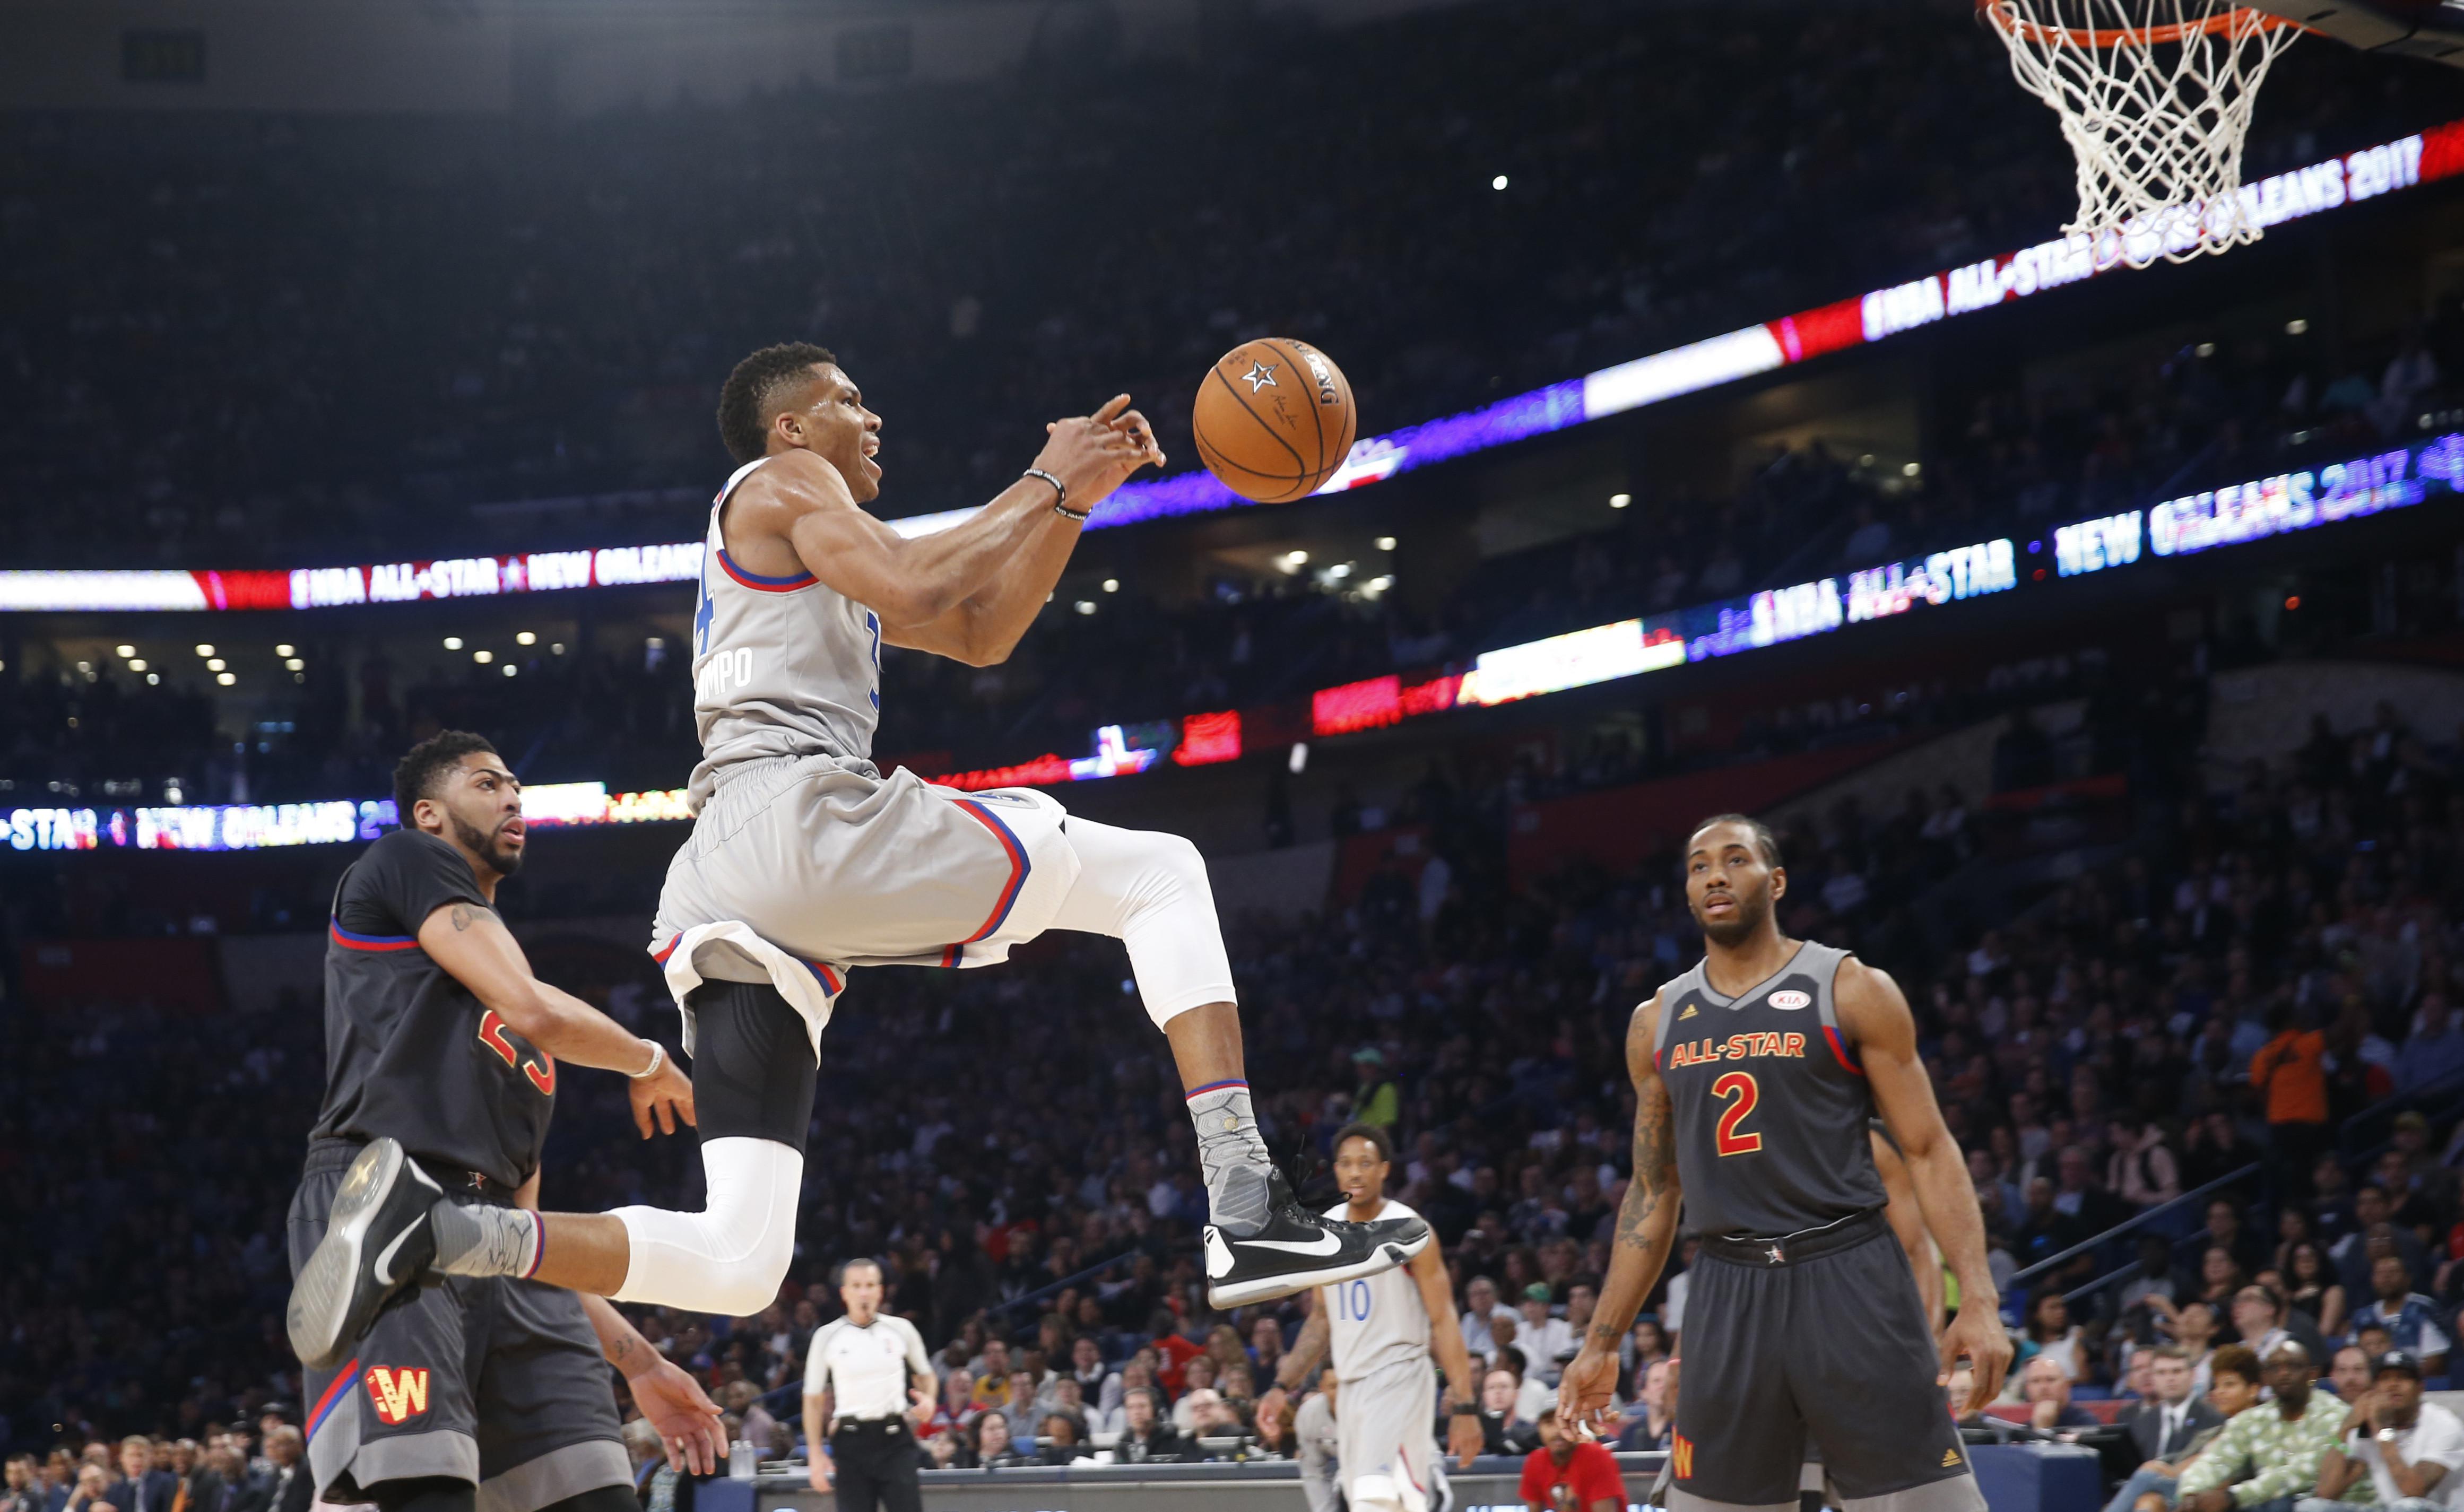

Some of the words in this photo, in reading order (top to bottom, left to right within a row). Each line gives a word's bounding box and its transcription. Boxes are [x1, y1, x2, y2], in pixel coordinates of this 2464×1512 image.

[1881, 275, 1945, 335] NBA
[2346, 133, 2423, 202] 2017
[2054, 510, 2142, 578] NEW
[2149, 471, 2315, 556] ORLEANS
[2320, 449, 2409, 522] 2017
[309, 567, 367, 607] NBA
[527, 550, 593, 591] NEW
[1773, 578, 1843, 639] NBA
[135, 807, 215, 849] NEW
[222, 800, 357, 849] ORLEANS
[1710, 1070, 1762, 1157] 2
[1338, 1280, 1371, 1322] 10
